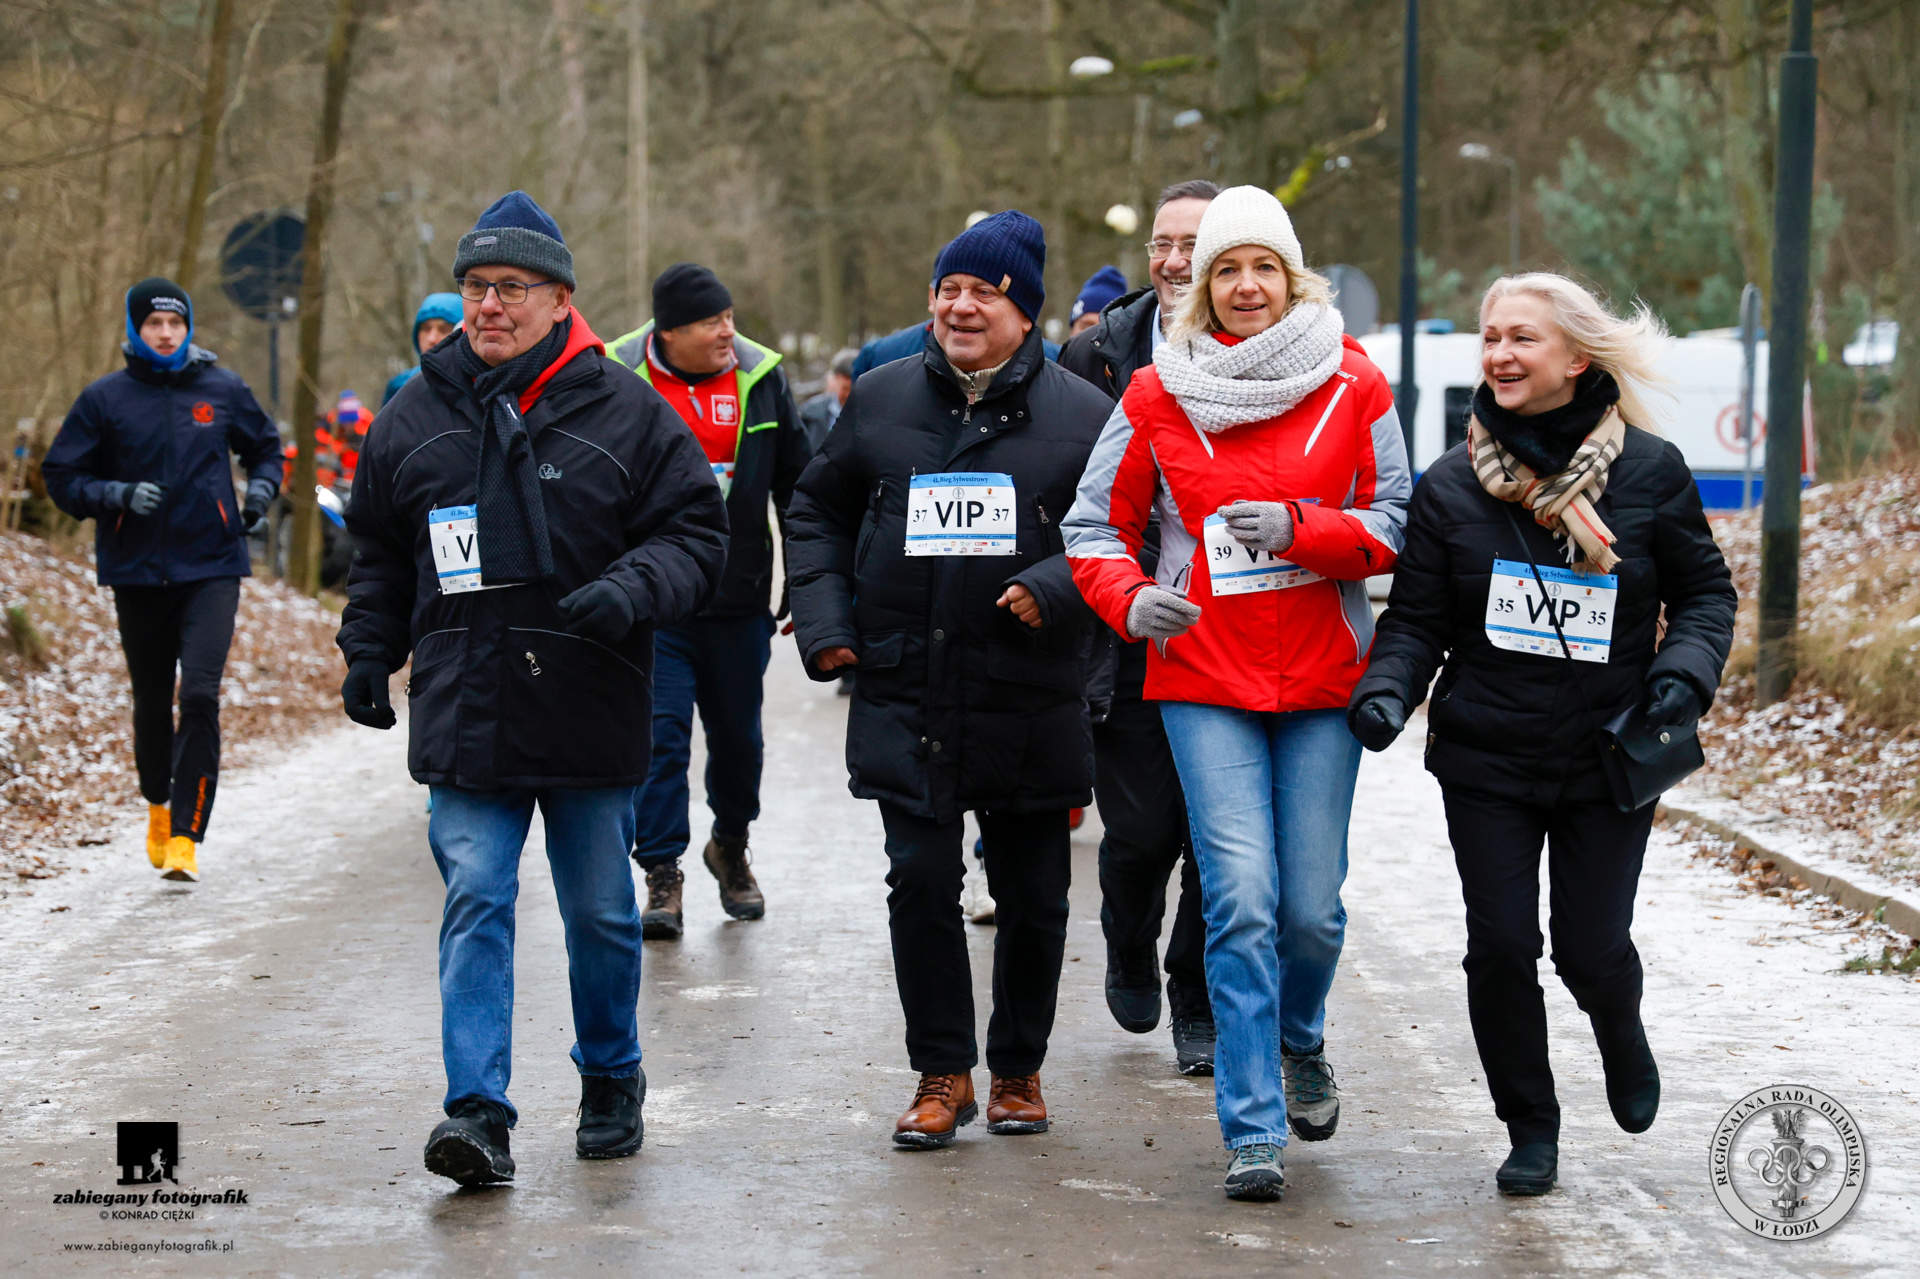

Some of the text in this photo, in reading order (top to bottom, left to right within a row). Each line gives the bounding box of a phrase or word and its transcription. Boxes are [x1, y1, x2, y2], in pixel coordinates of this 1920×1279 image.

[912, 500, 1010, 528] 37 VIP 37
[1214, 545, 1232, 560] 39
[1494, 594, 1607, 628] 35 VIP 35
